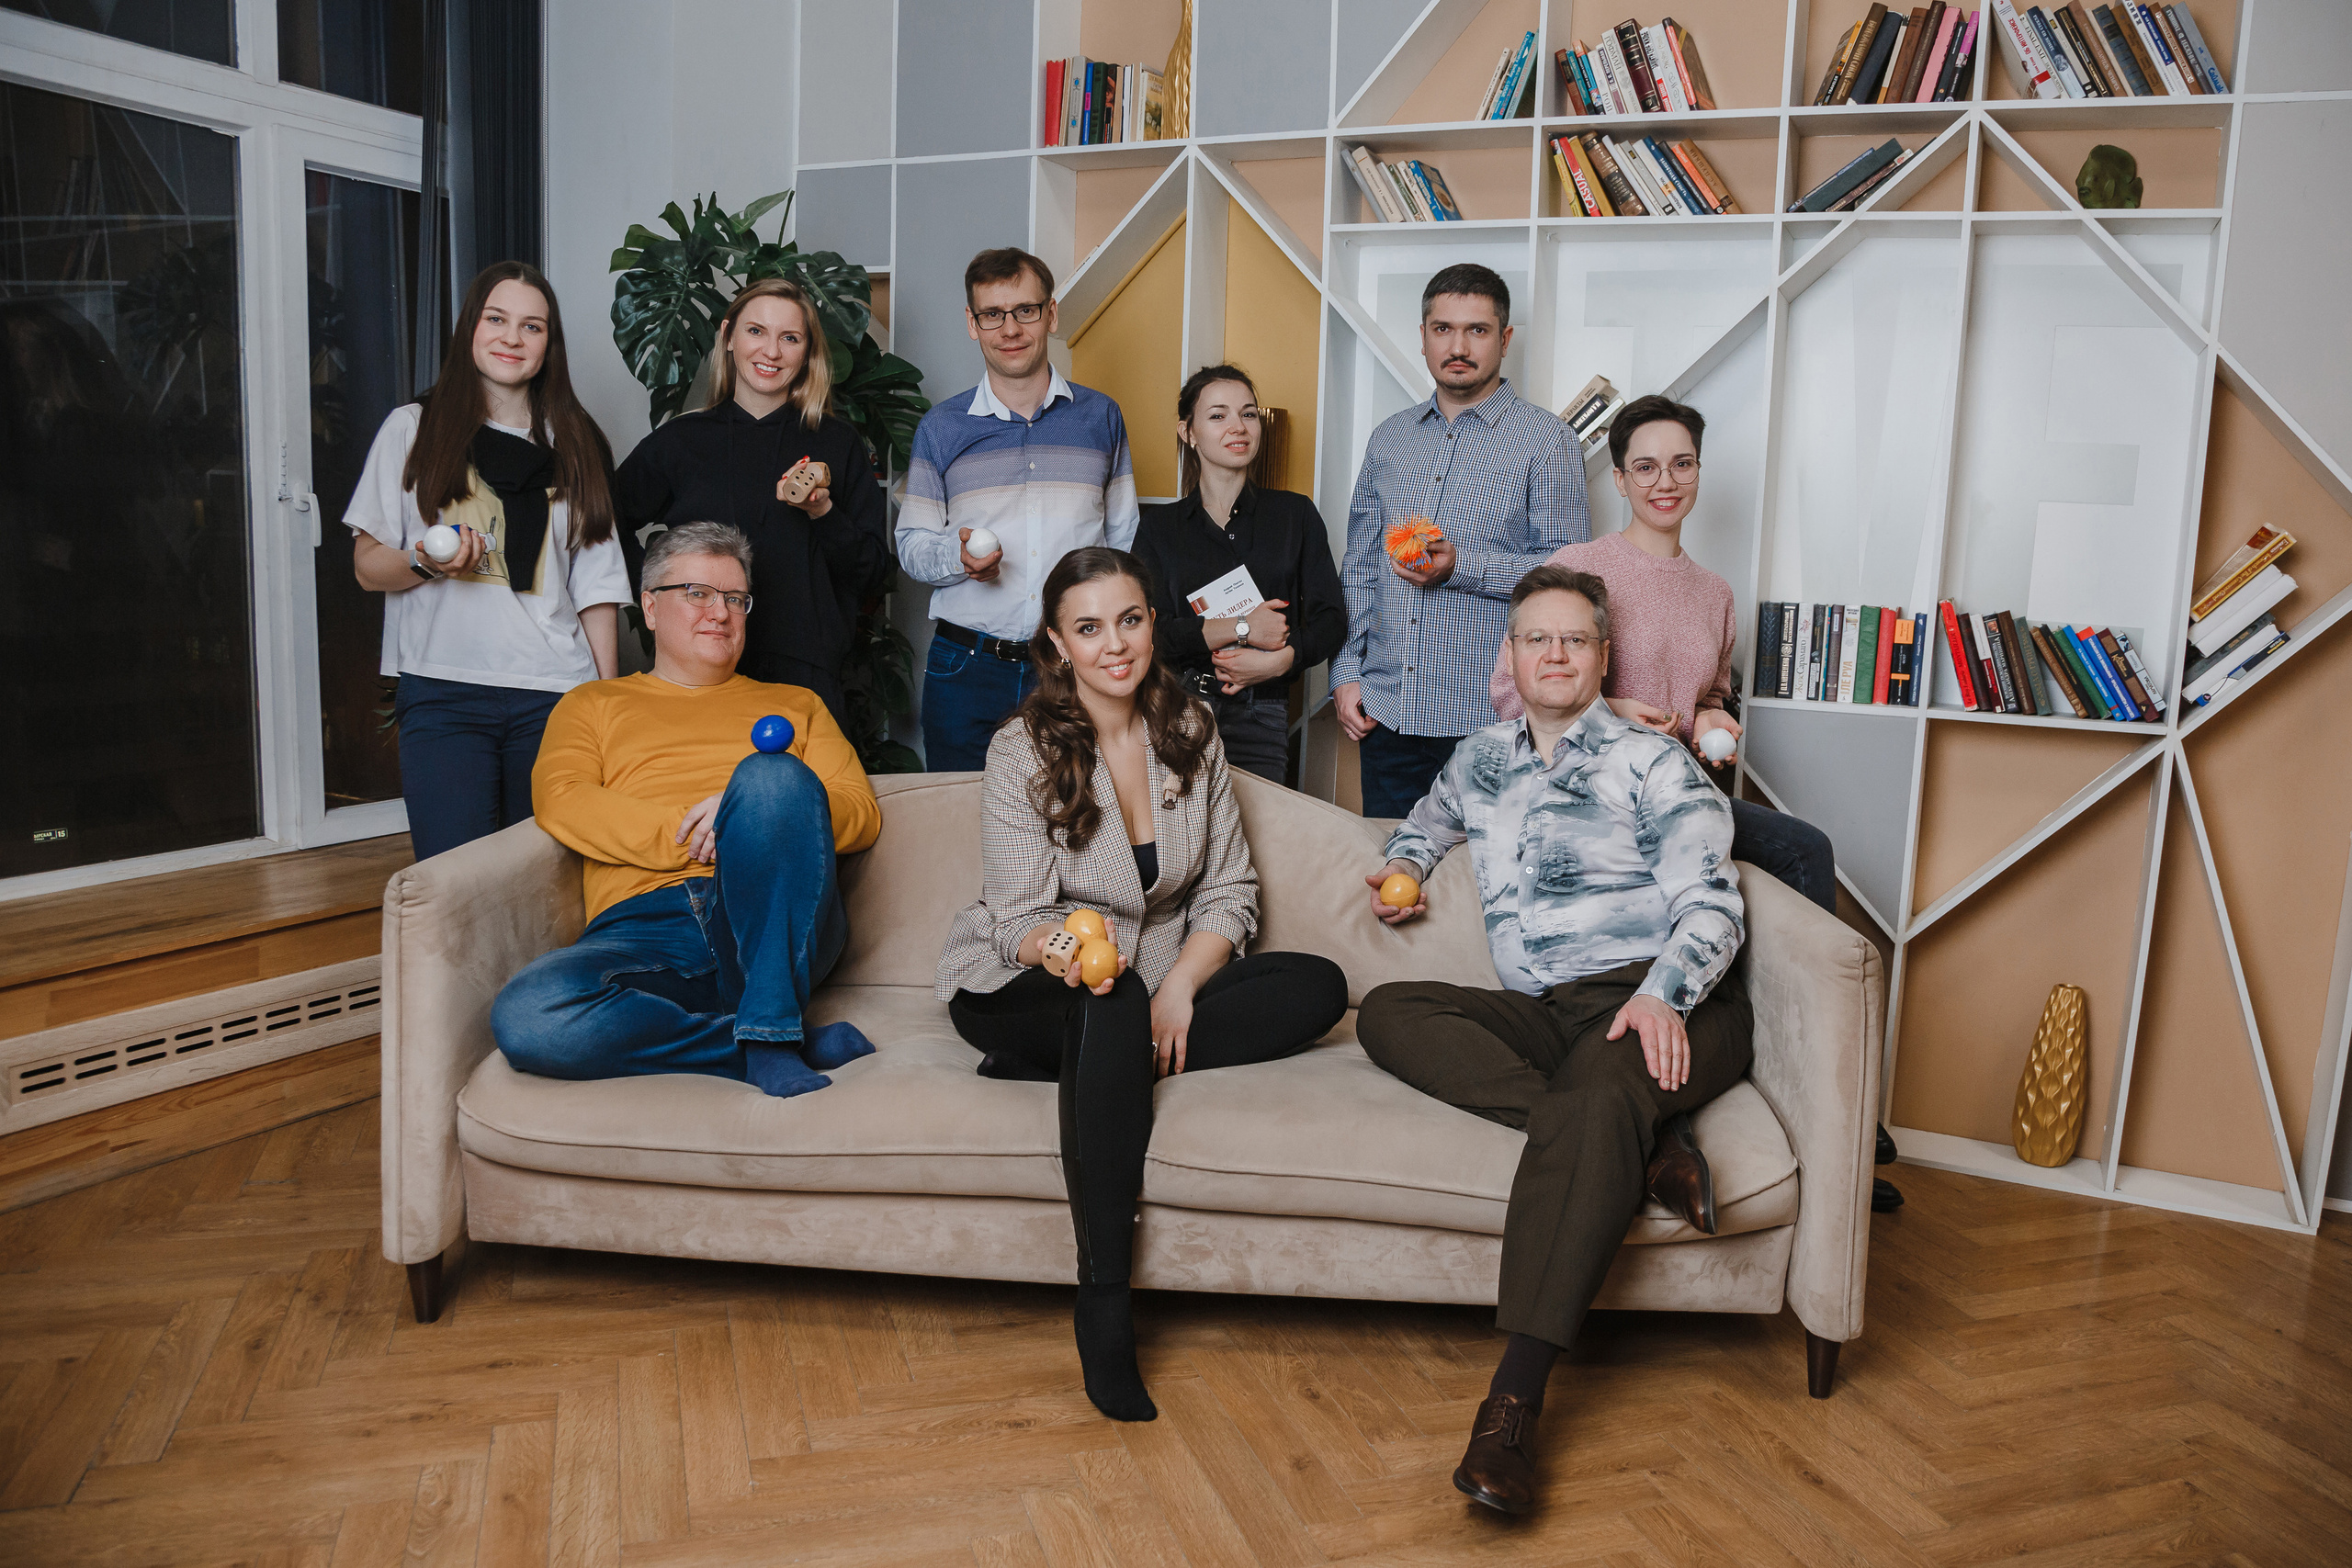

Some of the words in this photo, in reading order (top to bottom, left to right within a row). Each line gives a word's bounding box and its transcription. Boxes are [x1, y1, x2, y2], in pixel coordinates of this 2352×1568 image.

[2007, 17, 2028, 49] ИНТЕРФЕЙСЕ
[2023, 26, 2037, 43] FINAL
[2034, 43, 2046, 60] EXIT
[1603, 35, 1622, 71] ГОФМАН
[2023, 46, 2031, 55] ОБ
[1844, 59, 1860, 80] СПОК
[2206, 66, 2224, 93] Саймак
[1827, 74, 1838, 95] TRAVELER
[1689, 147, 1710, 176] ПУШКИН
[1572, 167, 1596, 209] CASUAL
[2251, 556, 2267, 570] Search
[2222, 575, 2243, 592] Common
[2240, 569, 2250, 579] The
[1225, 595, 1253, 615] ЛИДЕРА
[57, 829, 65, 838] 15
